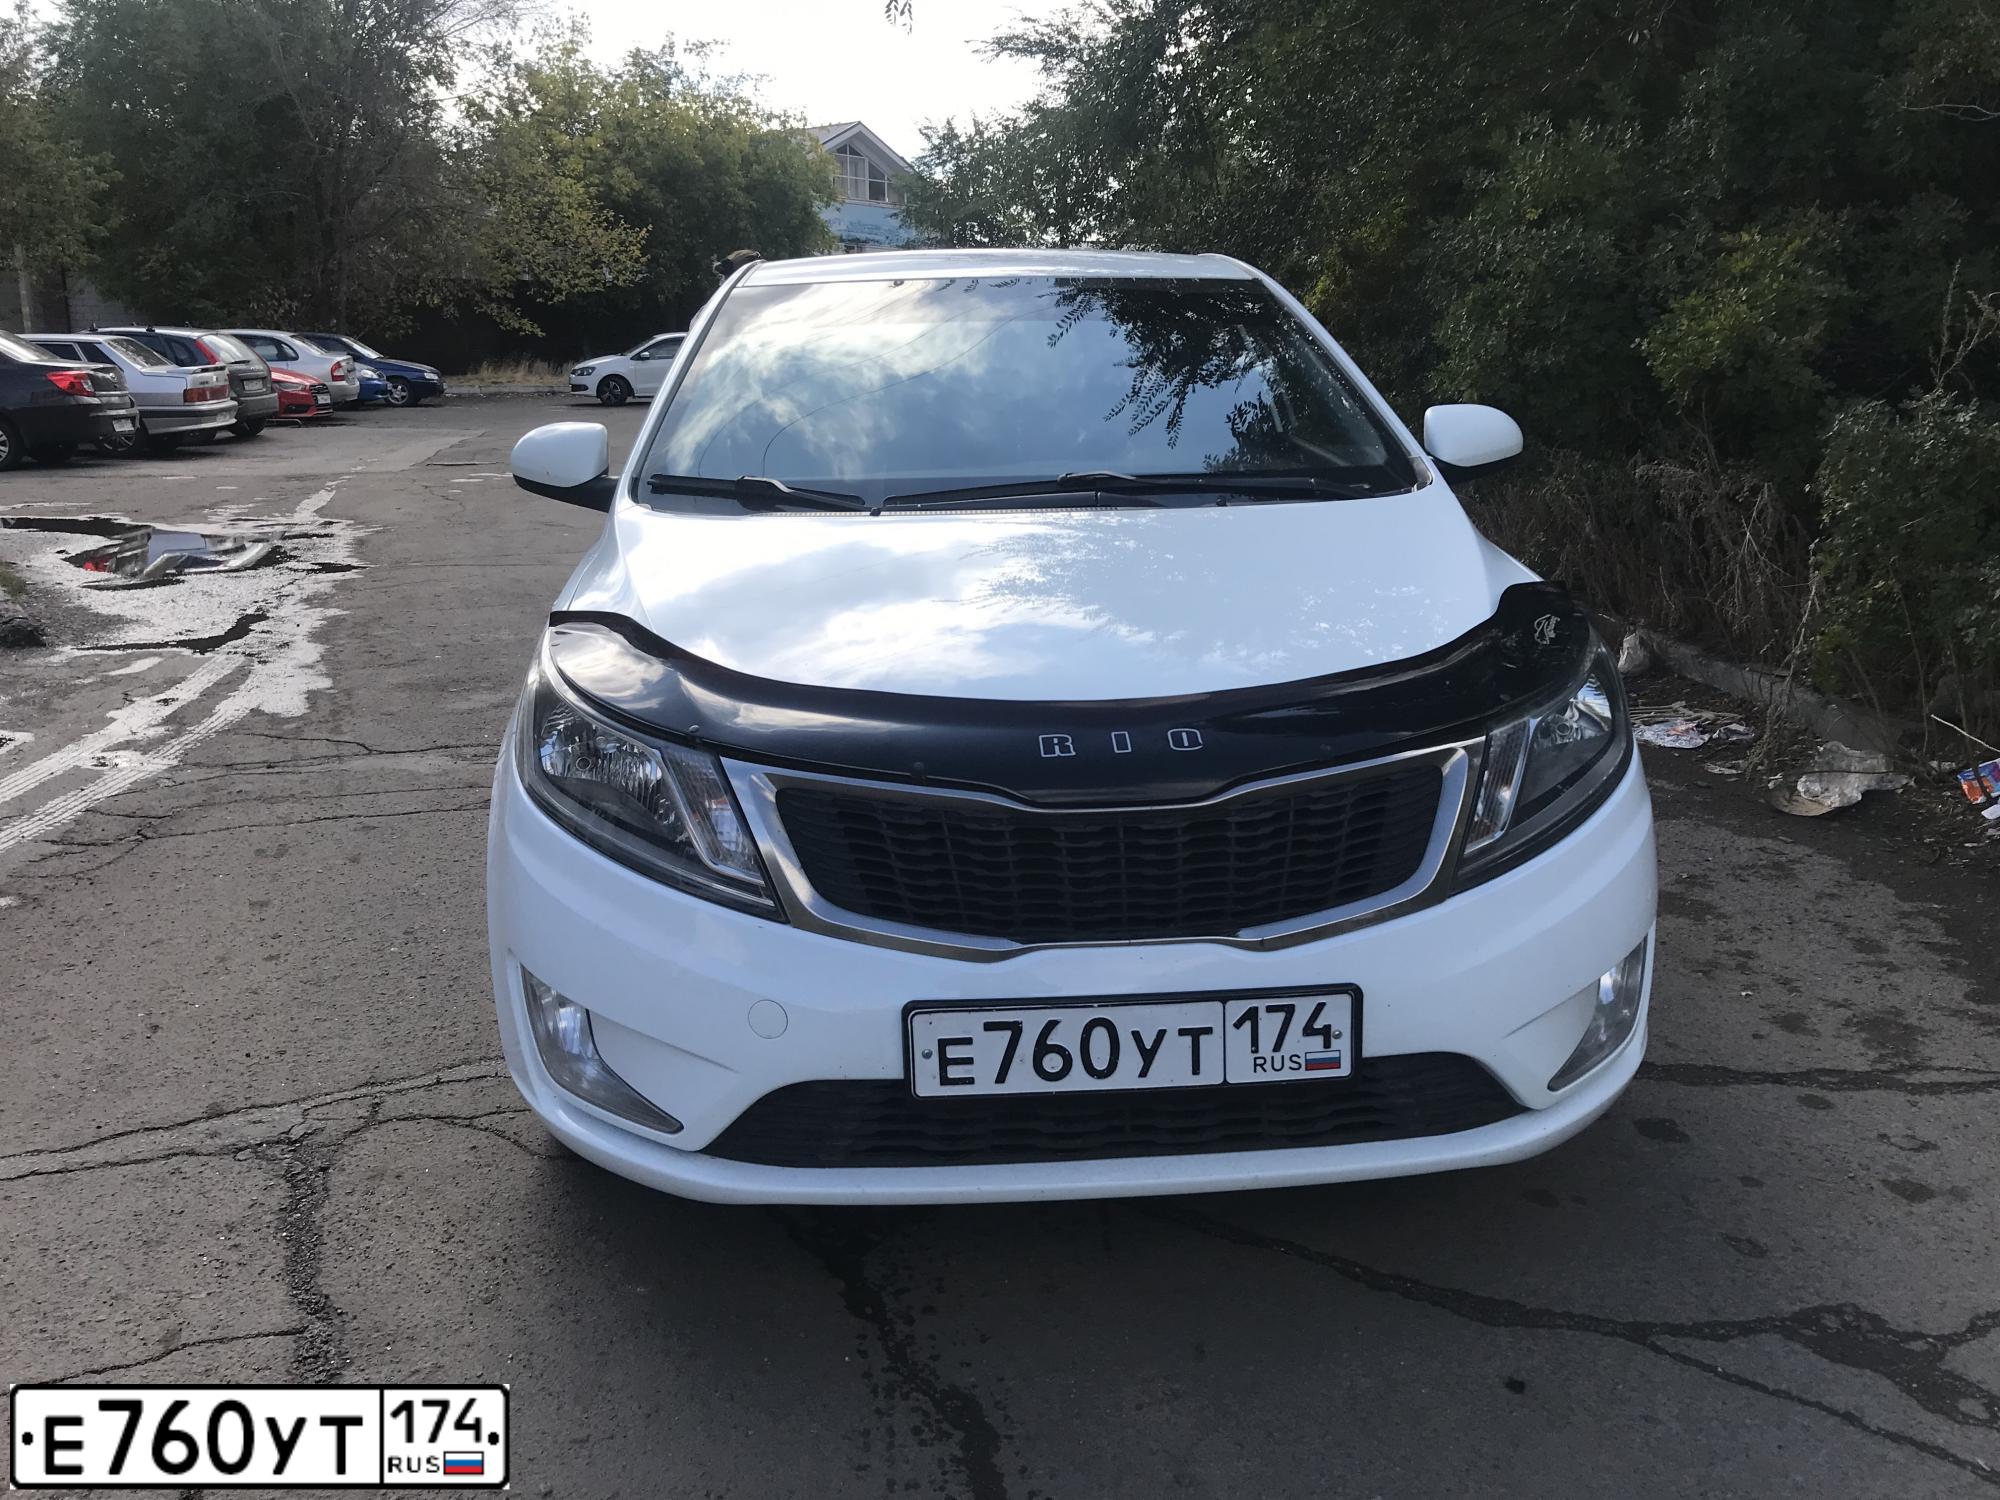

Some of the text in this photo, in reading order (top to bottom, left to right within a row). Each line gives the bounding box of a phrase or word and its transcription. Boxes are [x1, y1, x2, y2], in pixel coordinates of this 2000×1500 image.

[1038, 728, 1204, 758] RIO
[1232, 1001, 1332, 1054] 174
[1253, 1054, 1302, 1074] RUS
